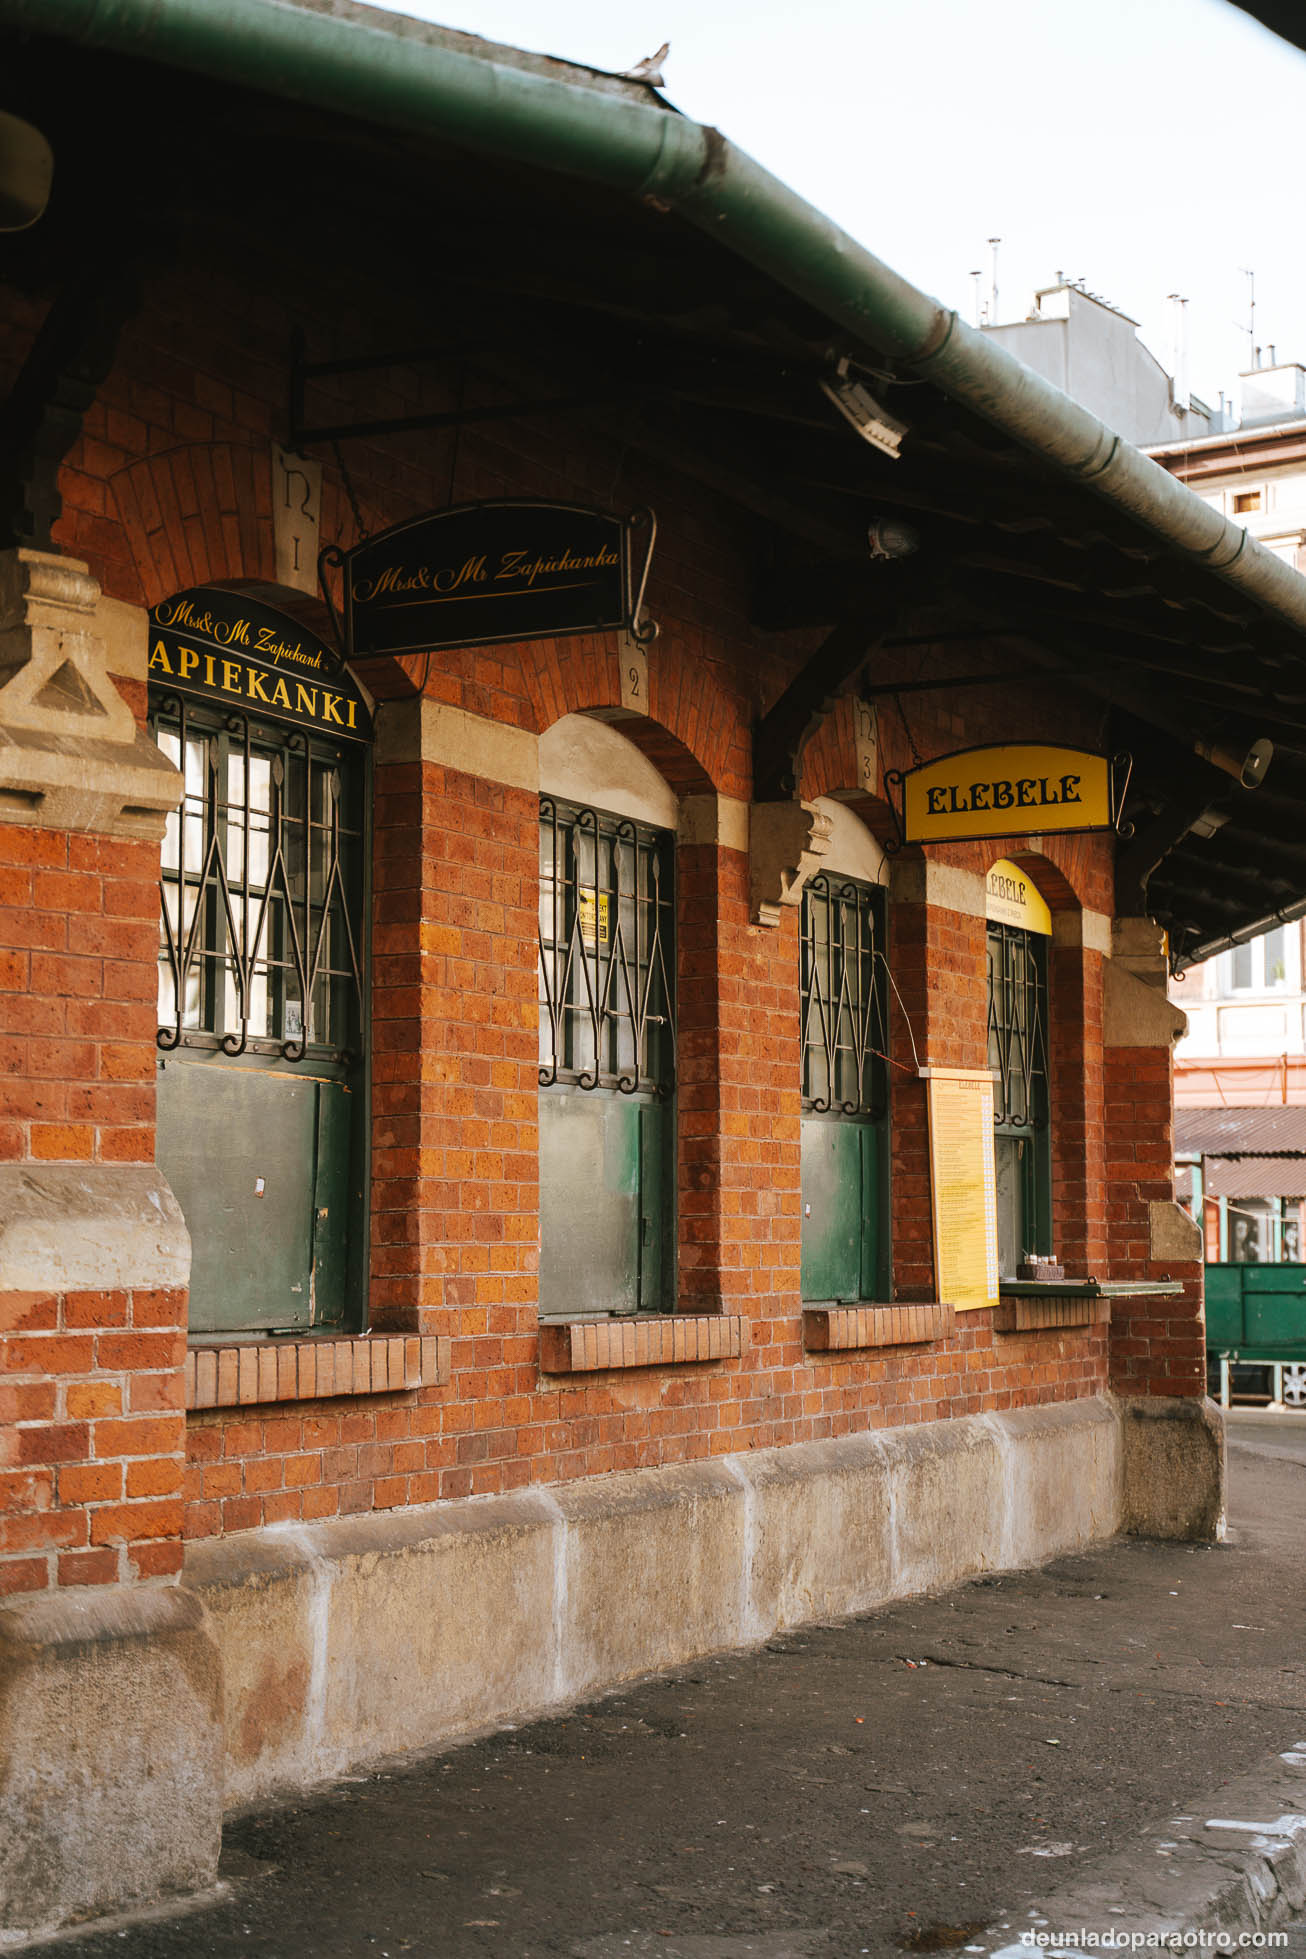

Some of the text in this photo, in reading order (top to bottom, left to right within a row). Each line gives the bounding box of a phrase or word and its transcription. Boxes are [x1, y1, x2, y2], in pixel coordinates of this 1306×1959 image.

[433, 554, 488, 592] Mr
[496, 543, 619, 586] Zapiekanka
[213, 618, 250, 645] Mr
[253, 627, 324, 670] Zapiekank
[926, 774, 1082, 815] ELEBELE
